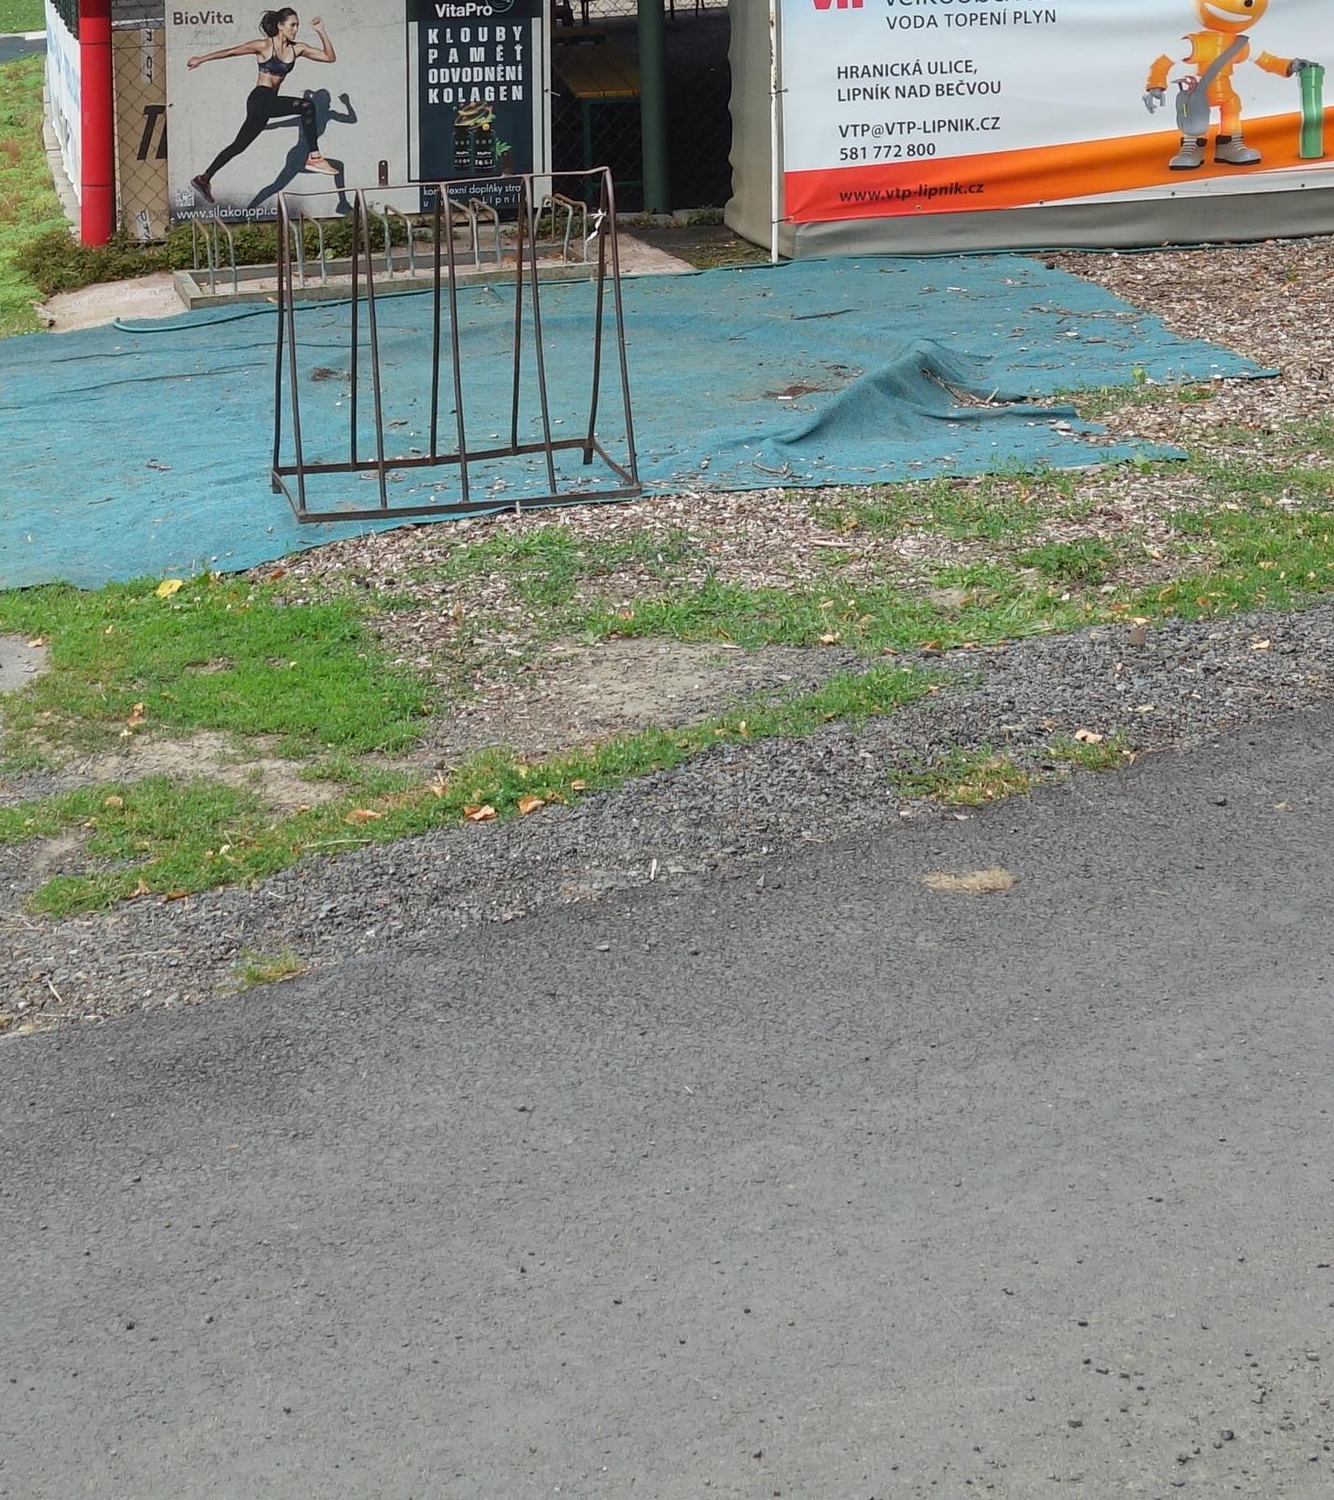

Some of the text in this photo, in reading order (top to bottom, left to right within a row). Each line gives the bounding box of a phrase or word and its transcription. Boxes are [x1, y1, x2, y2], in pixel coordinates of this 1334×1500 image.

[172, 11, 234, 25] BioVita
[435, 3, 493, 18] VitaPro
[886, 8, 1057, 30] VODA TOPENÍ PLYN
[428, 26, 523, 44] KLOUBY
[428, 63, 523, 83] ODVODNĚNÍ
[837, 59, 977, 80] HRANICKÁ ULICE,
[428, 85, 524, 104] KOLAGEN
[837, 80, 1001, 102] LIPNÍK NAD BEČVOU
[839, 116, 1001, 138] VTP@VTP-LIPNIK.CZ
[839, 142, 936, 161] 581 772 800
[469, 183, 503, 196] doplňky
[839, 182, 984, 202] www.vtp-lipnik.cz
[176, 205, 279, 220] www.silakonopi.c
